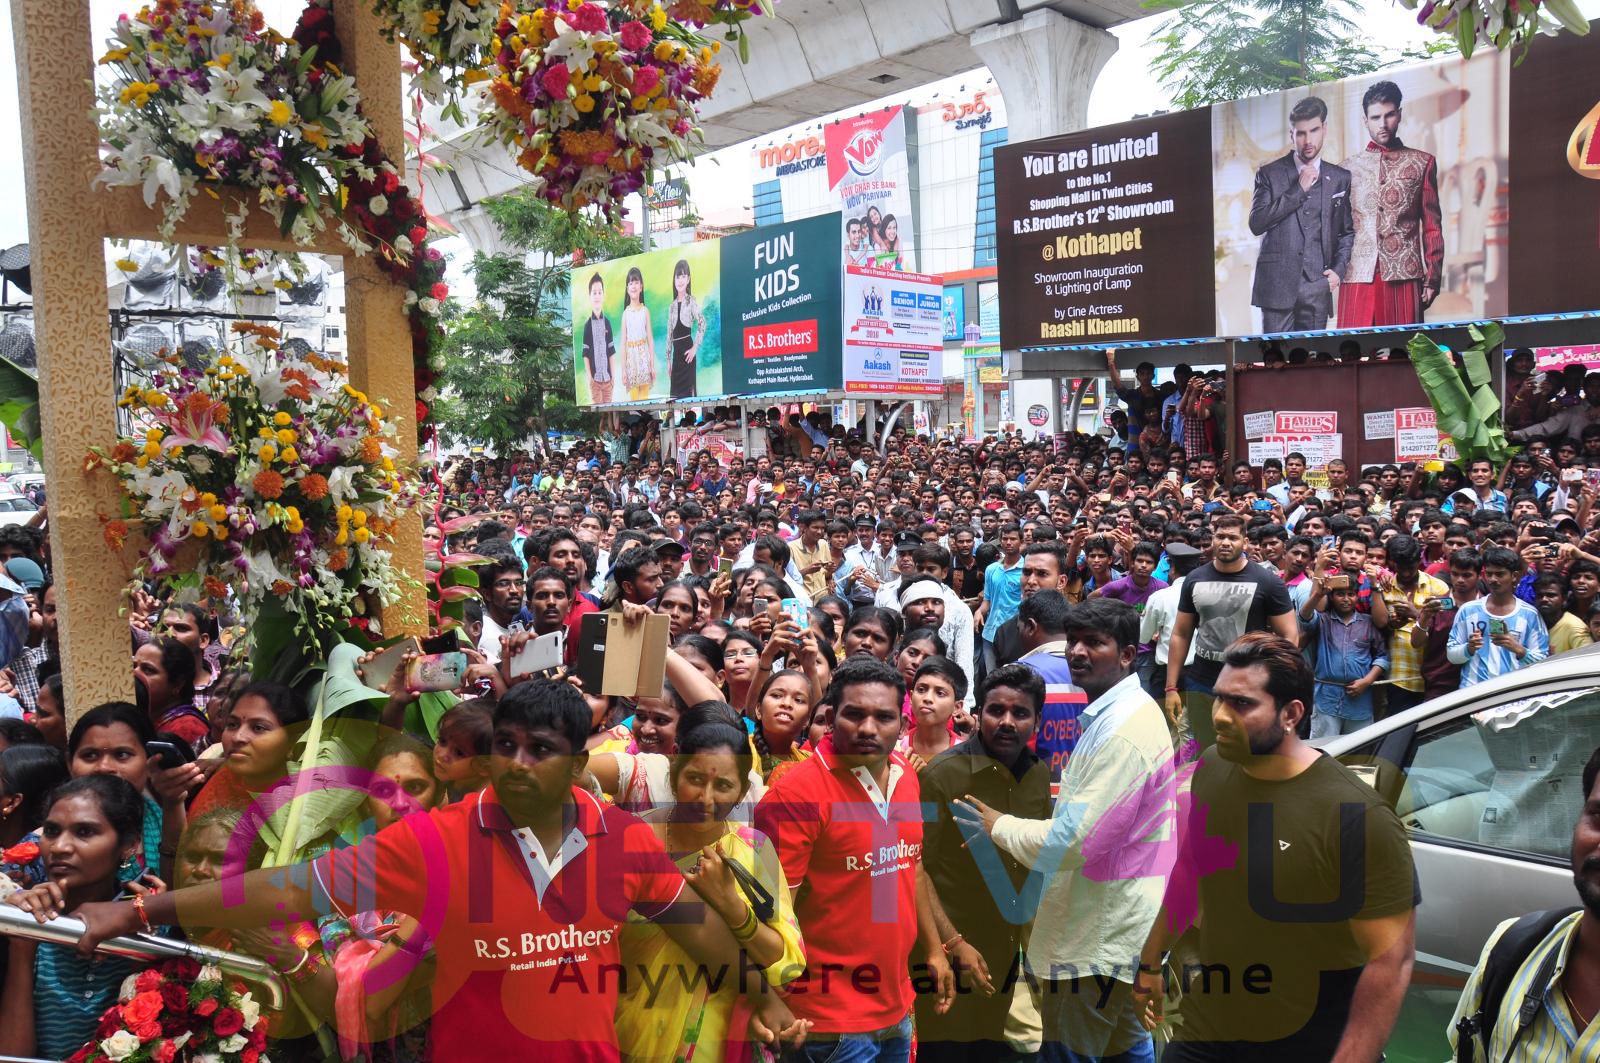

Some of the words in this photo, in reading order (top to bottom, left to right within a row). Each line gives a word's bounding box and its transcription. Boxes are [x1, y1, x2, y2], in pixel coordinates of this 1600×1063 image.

[1022, 154, 1054, 178] You
[1058, 149, 1088, 172] are
[1091, 132, 1159, 166] invited
[776, 155, 826, 176] MEGASTORE
[855, 182, 870, 192] GHAR
[872, 181, 880, 189] SE
[1066, 178, 1075, 189] to
[1077, 175, 1091, 187] the
[1093, 171, 1111, 186] No.1
[863, 191, 892, 200] PARIVAAR
[1030, 195, 1070, 211] Shopping
[1071, 191, 1090, 203] Mall
[1092, 190, 1101, 200] in
[1102, 186, 1124, 199] Twin
[1125, 182, 1153, 196] Cities
[1013, 211, 1084, 234] R.S.Brother's
[1086, 205, 1106, 224] 12th
[1107, 199, 1174, 221] Showroom
[754, 231, 794, 270] FUN
[1034, 271, 1081, 284] Showroom
[1083, 263, 1143, 279] Inauguration
[754, 264, 800, 303] KIDS
[1045, 285, 1052, 296] &
[1055, 282, 1091, 296] Lighting
[1093, 280, 1103, 290] of
[1105, 279, 1131, 290] Lamp
[742, 308, 767, 321] Exclusive
[768, 302, 780, 313] Kids
[781, 293, 812, 308] Collection
[894, 298, 914, 306] SENIOR
[920, 301, 939, 309] JUNIOR
[862, 308, 883, 316] Aakash
[1055, 308, 1065, 320] by
[1067, 306, 1086, 317] Cine
[1088, 304, 1122, 315] Actress
[1041, 320, 1085, 338] Raashi
[1087, 318, 1139, 335] Khanna
[749, 334, 766, 350] R.S.
[767, 329, 812, 348] Brothers
[864, 360, 891, 370] Aakash
[901, 368, 928, 376] KOTHAPET
[1246, 413, 1272, 421] WANTED
[846, 852, 876, 871] R.S.
[474, 937, 517, 959] R.S.
[520, 924, 614, 955] Brothers
[510, 961, 534, 971] Retail
[536, 958, 557, 967] India
[558, 955, 574, 964] Pvt.
[574, 953, 589, 962] Ltd.
